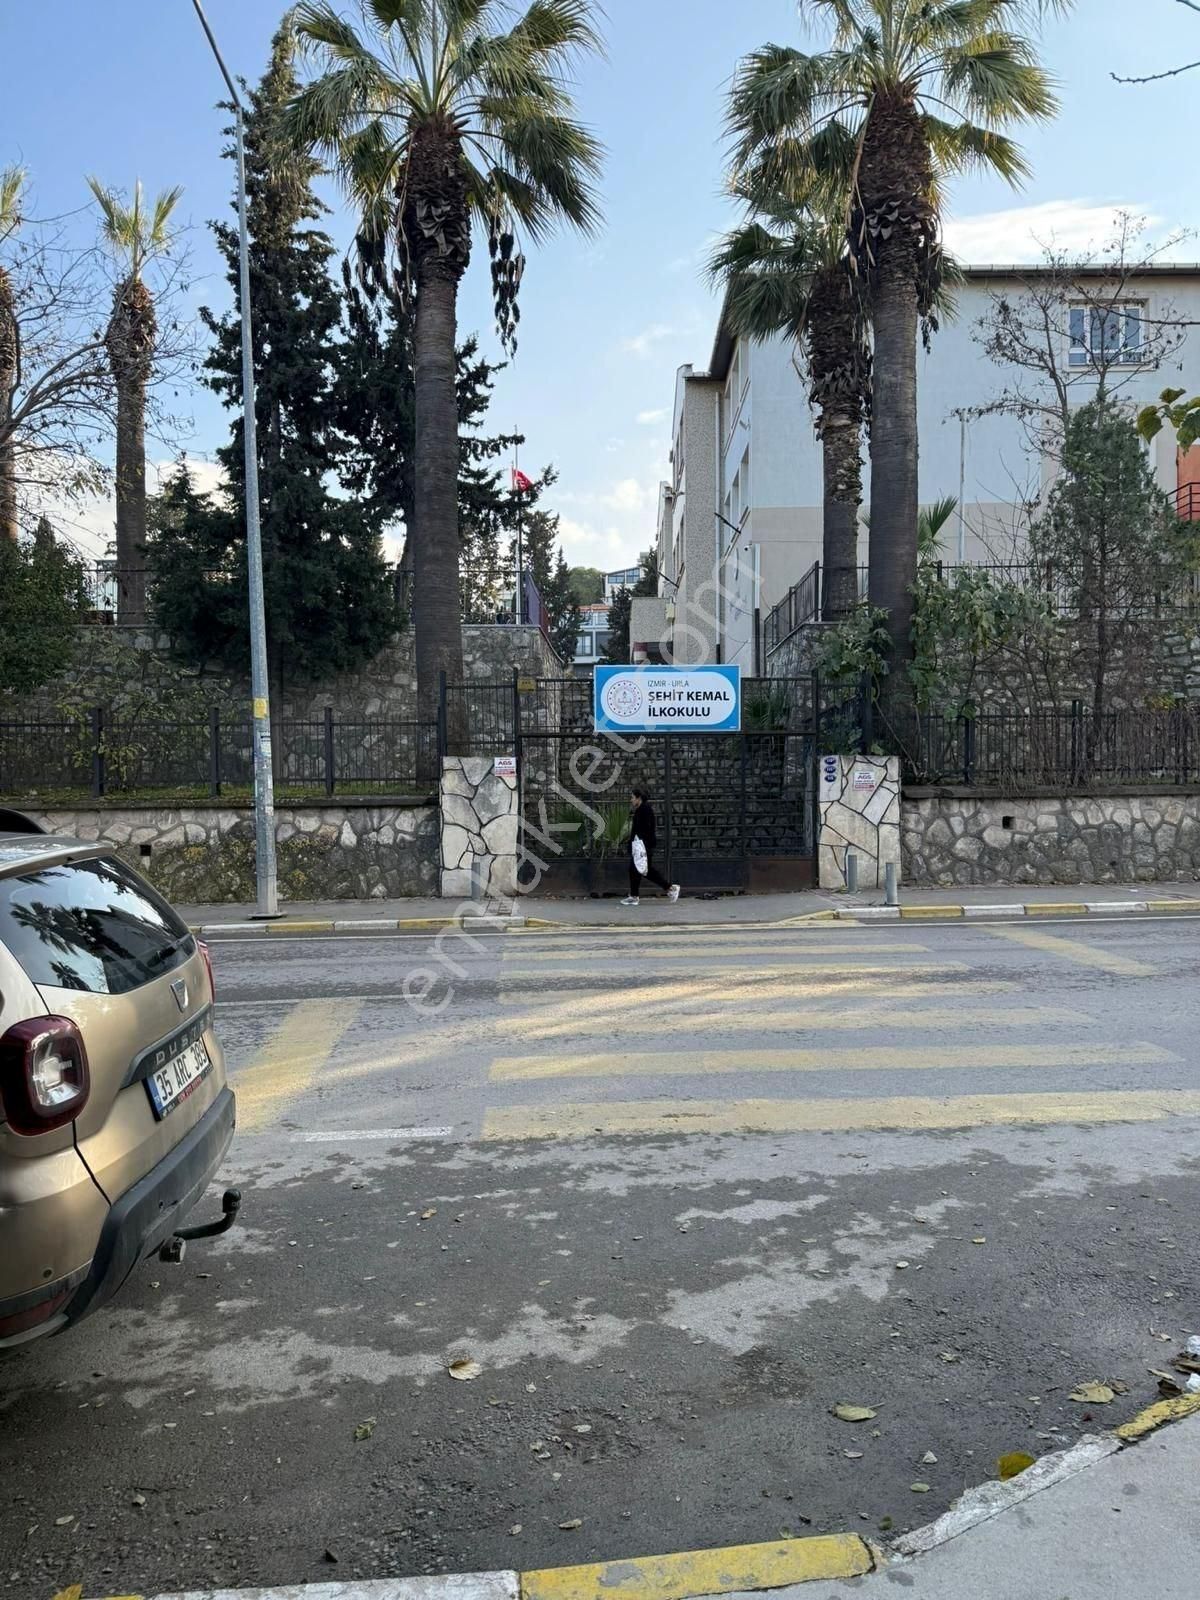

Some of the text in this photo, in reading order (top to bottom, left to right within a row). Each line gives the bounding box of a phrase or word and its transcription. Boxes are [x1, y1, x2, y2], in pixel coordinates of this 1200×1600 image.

[648, 689, 684, 704] ŞEHİT
[687, 691, 730, 701] KEMAL
[648, 705, 710, 717] İLKOKULU
[156, 1069, 173, 1101] 35
[172, 1054, 191, 1088] ARC
